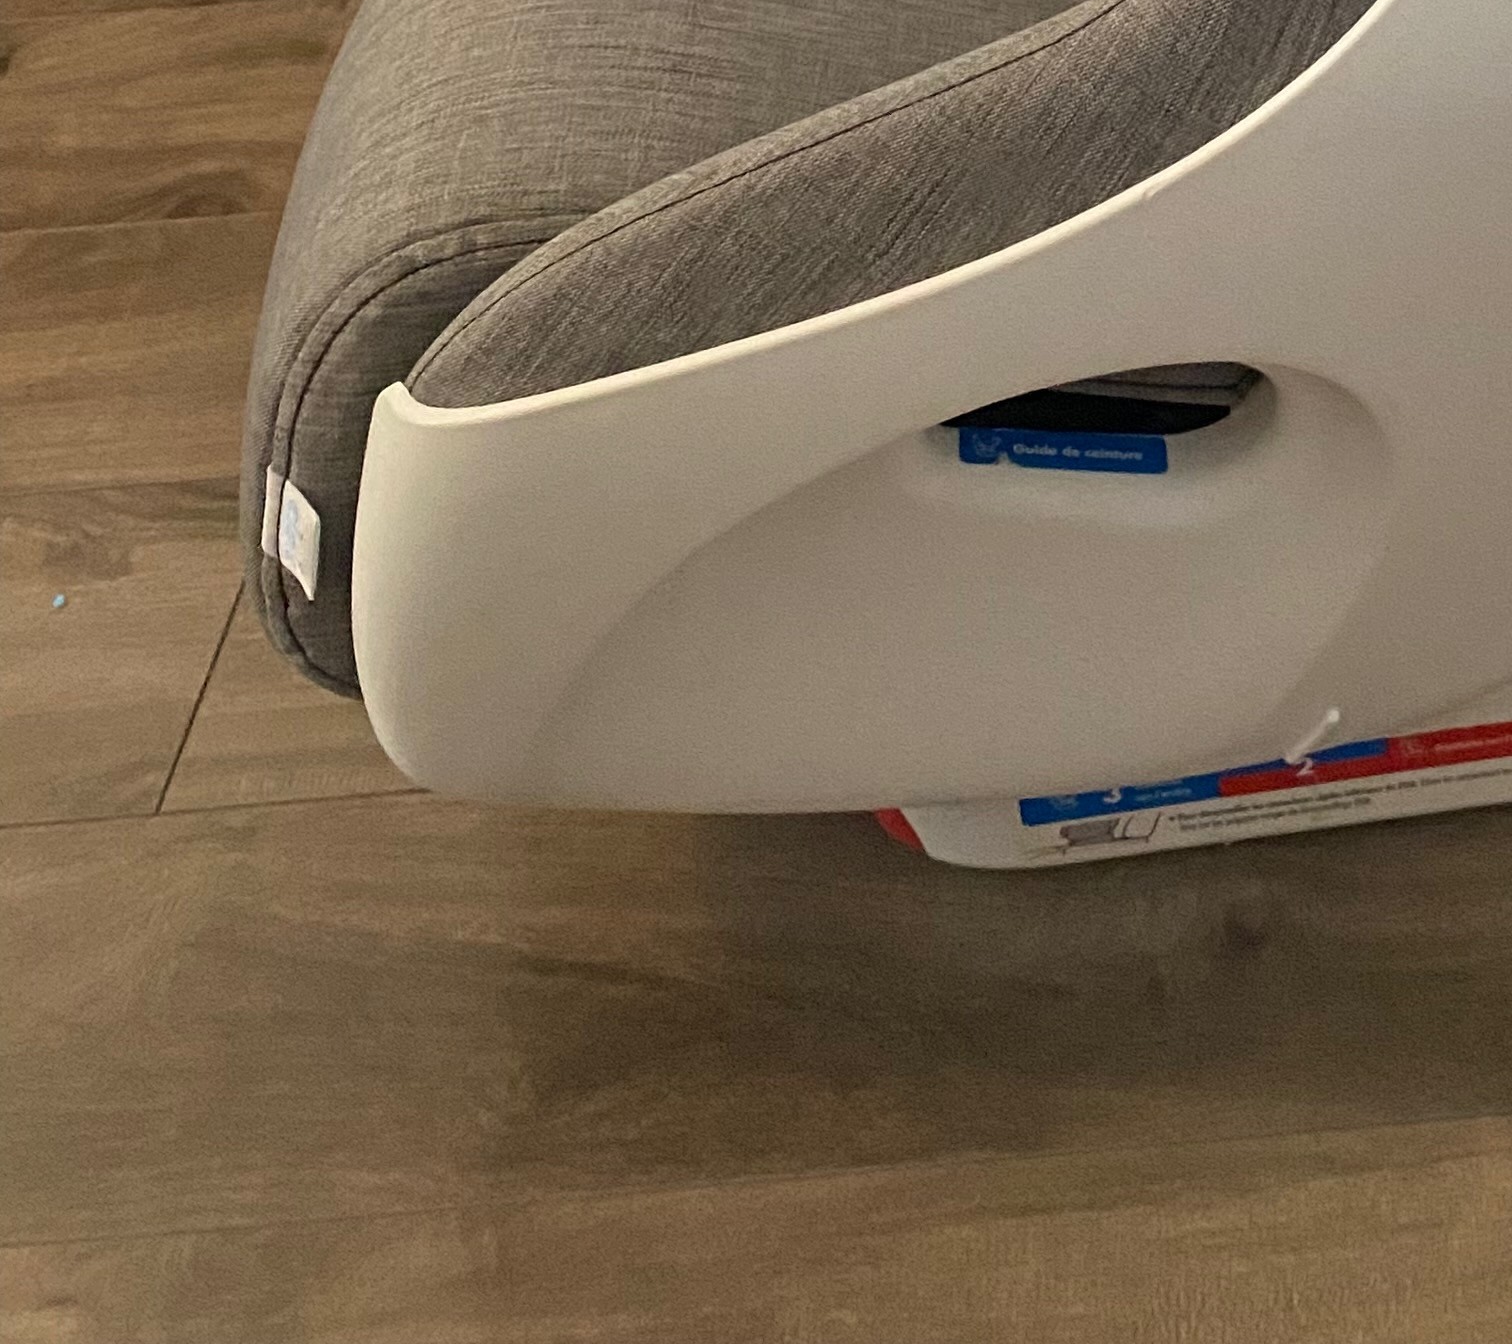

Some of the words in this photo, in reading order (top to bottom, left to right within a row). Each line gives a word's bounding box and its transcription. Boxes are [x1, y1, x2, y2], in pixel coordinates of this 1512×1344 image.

[1013, 443, 1057, 456] Guide
[1062, 445, 1080, 457] de
[1084, 449, 1143, 460] ceinture
[1296, 757, 1314, 777] 2
